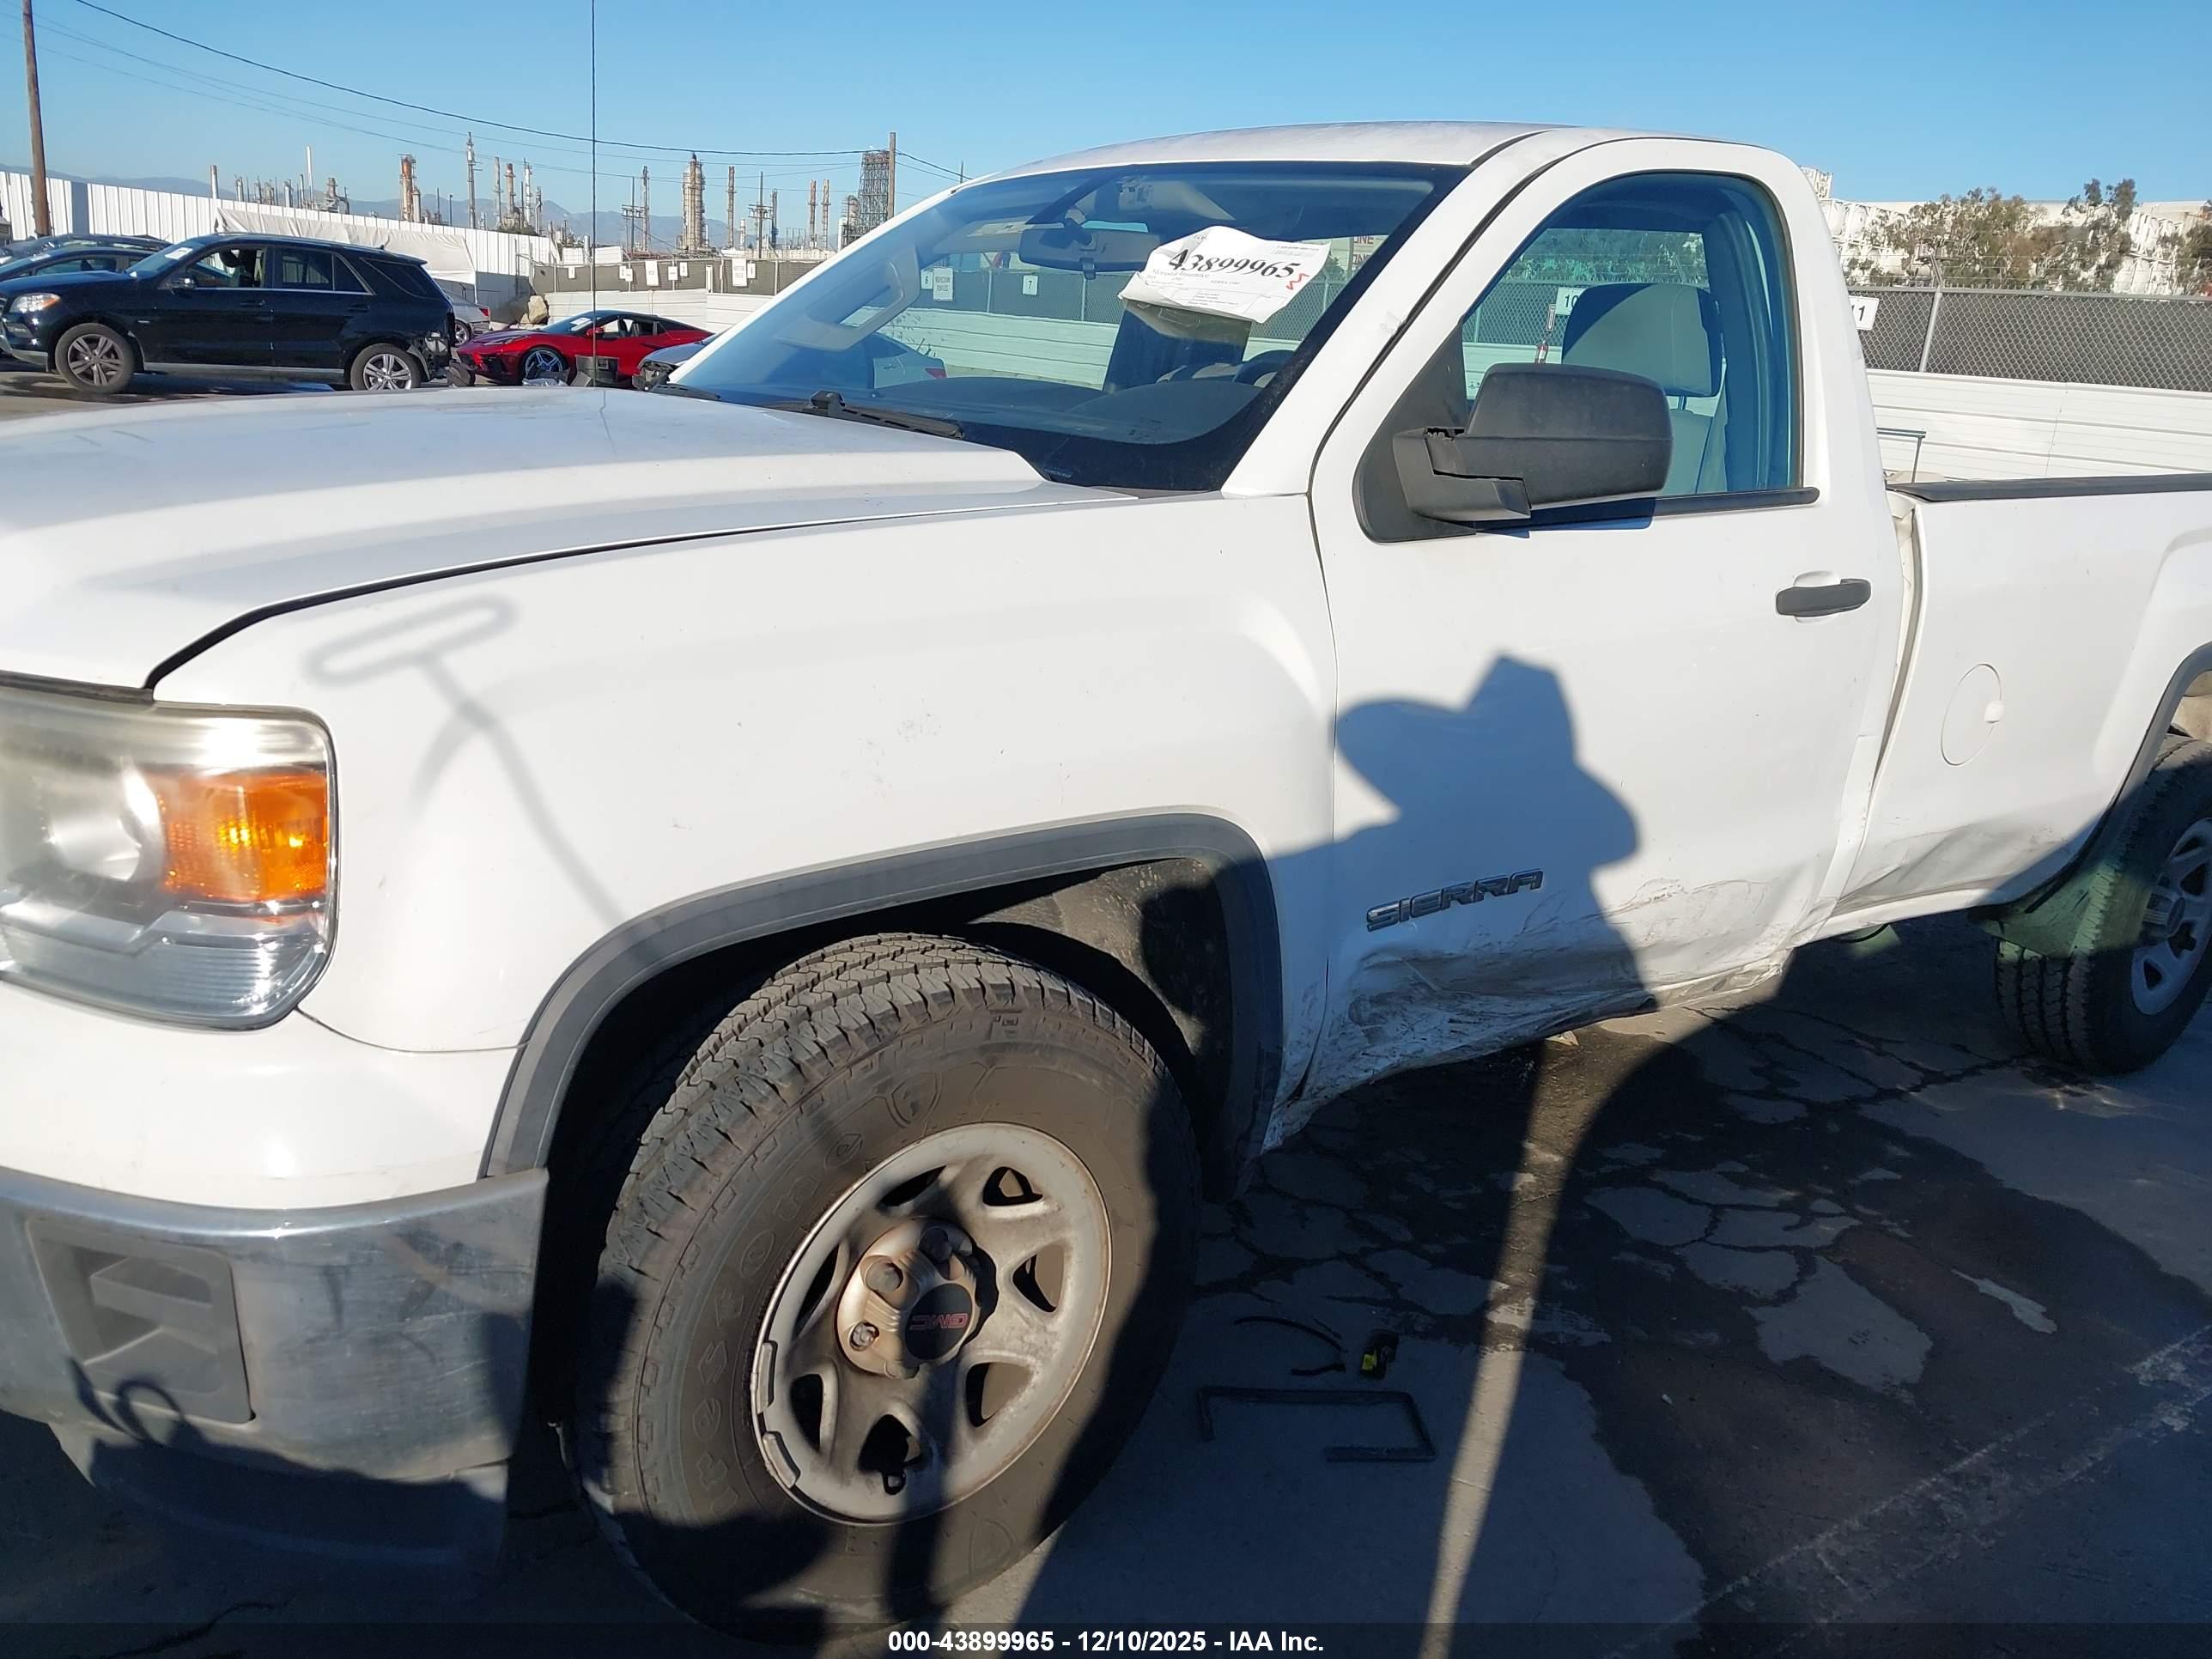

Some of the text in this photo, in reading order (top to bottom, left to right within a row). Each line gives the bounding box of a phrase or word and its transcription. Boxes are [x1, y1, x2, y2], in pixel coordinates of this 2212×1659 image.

[1169, 248, 1302, 278] 43899965
[1365, 867, 1544, 933] SIERRA
[909, 1312, 969, 1331] GMC
